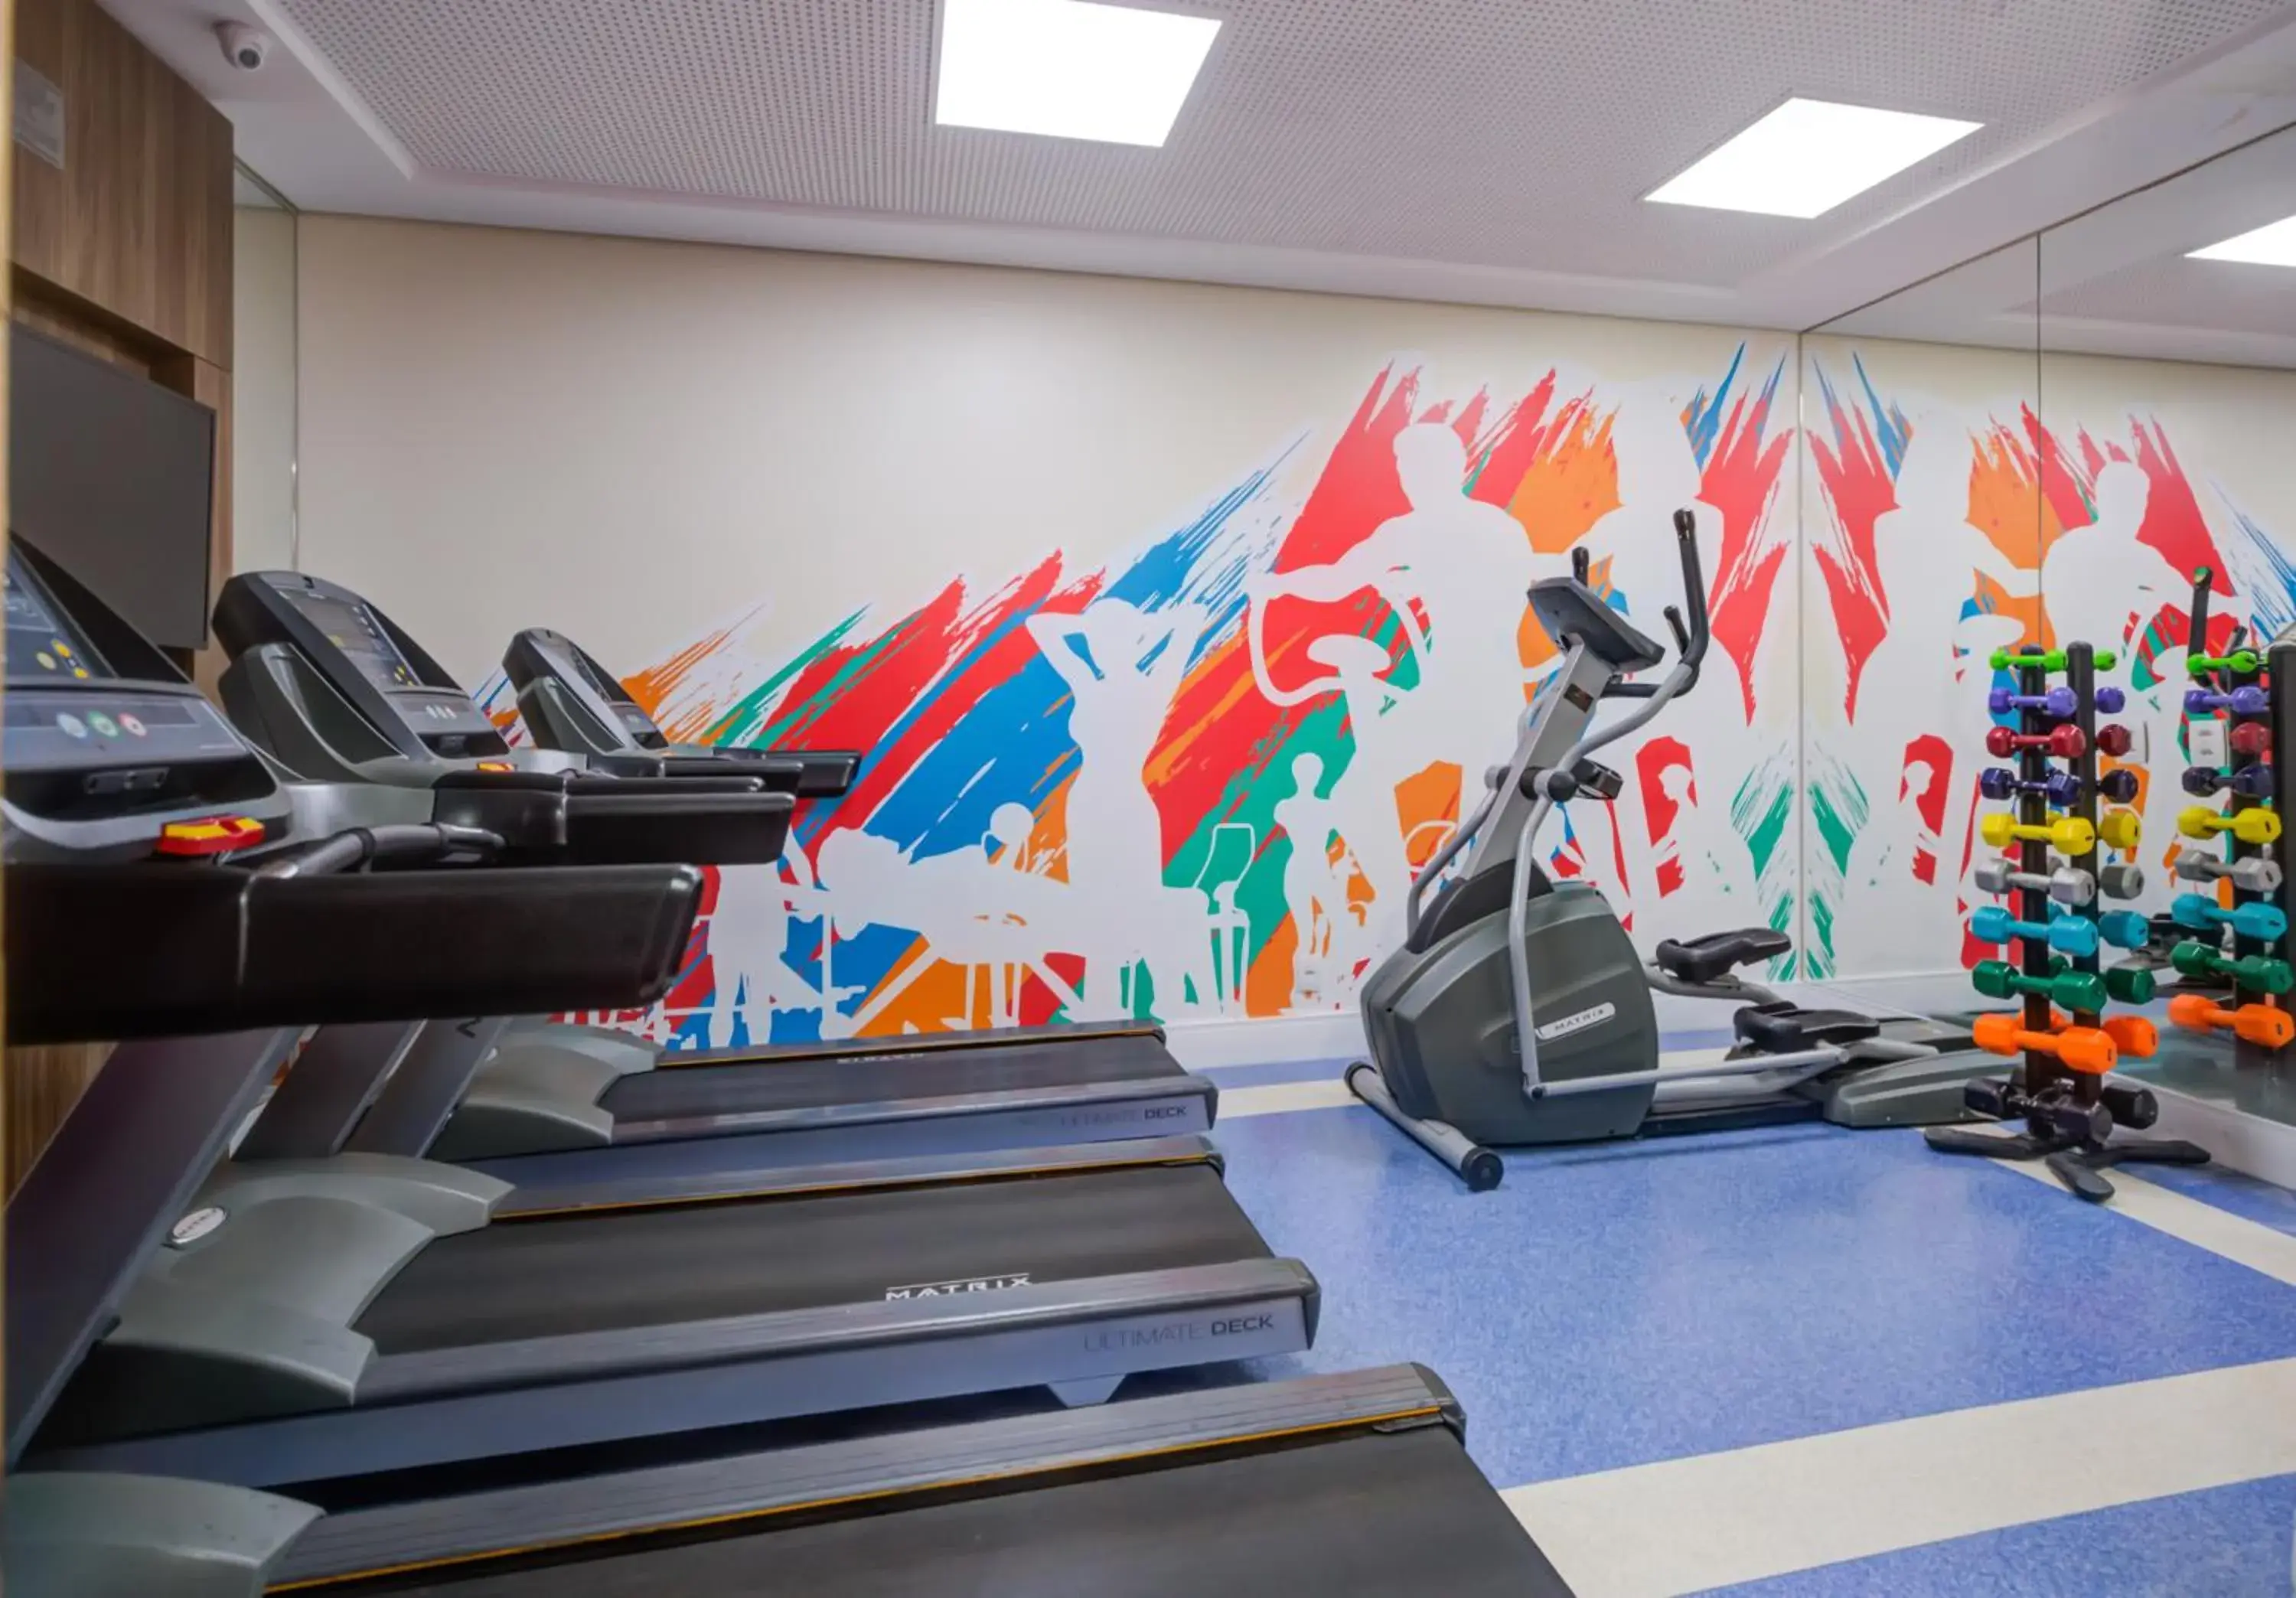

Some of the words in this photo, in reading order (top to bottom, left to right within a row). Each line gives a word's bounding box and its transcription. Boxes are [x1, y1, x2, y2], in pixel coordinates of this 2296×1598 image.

[1144, 1105, 1187, 1120] DECK
[886, 1276, 1030, 1301] MATRIX
[1084, 1323, 1204, 1353] ULTIMATE
[1211, 1314, 1274, 1336] DECK
